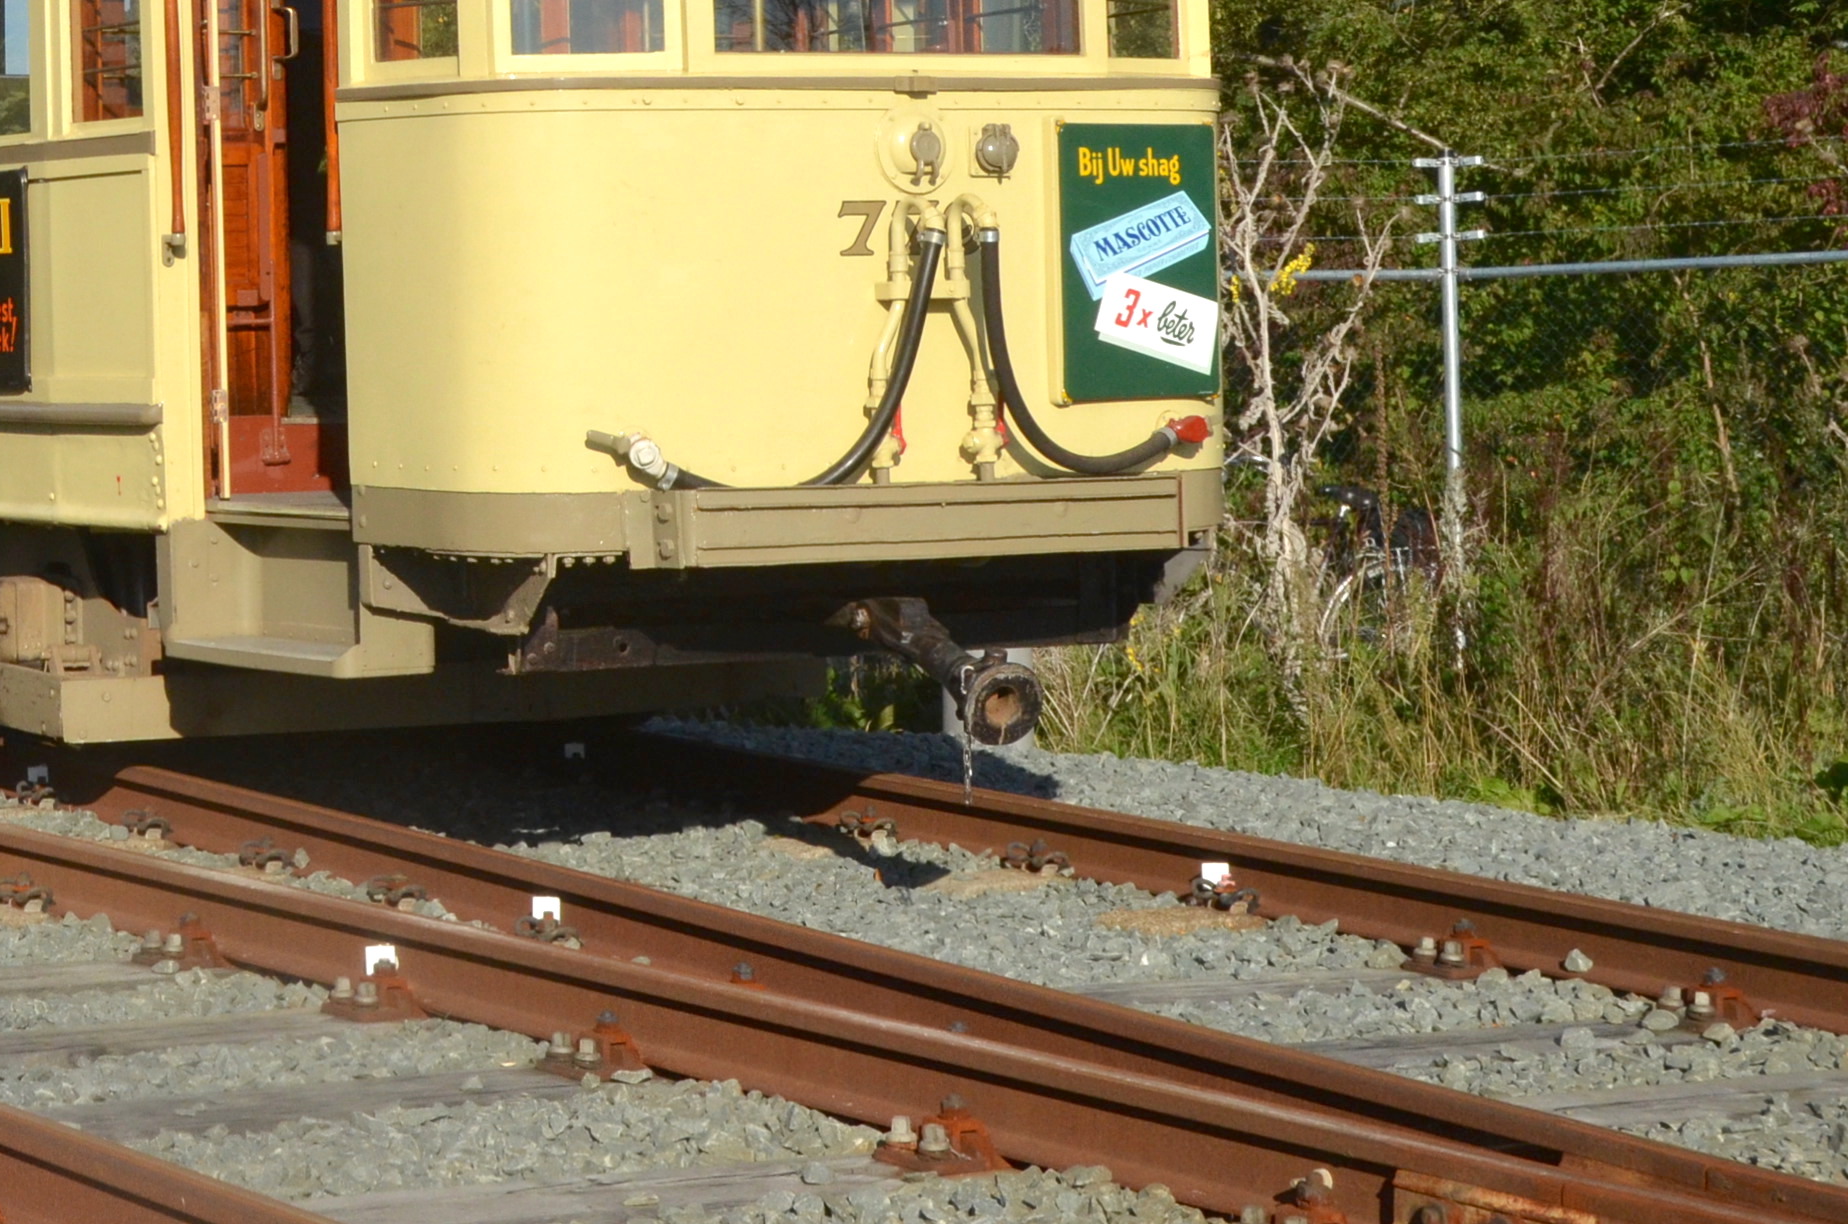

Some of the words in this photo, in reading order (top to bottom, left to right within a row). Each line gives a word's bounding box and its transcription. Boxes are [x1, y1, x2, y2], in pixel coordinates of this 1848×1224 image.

[1078, 146, 1104, 185] Bij
[1107, 147, 1135, 177] Uw
[1138, 146, 1181, 186] shag
[1093, 205, 1192, 262] MASCOTTE
[1114, 288, 1141, 328] 3
[1136, 308, 1154, 328] x
[1156, 300, 1196, 344] beter
